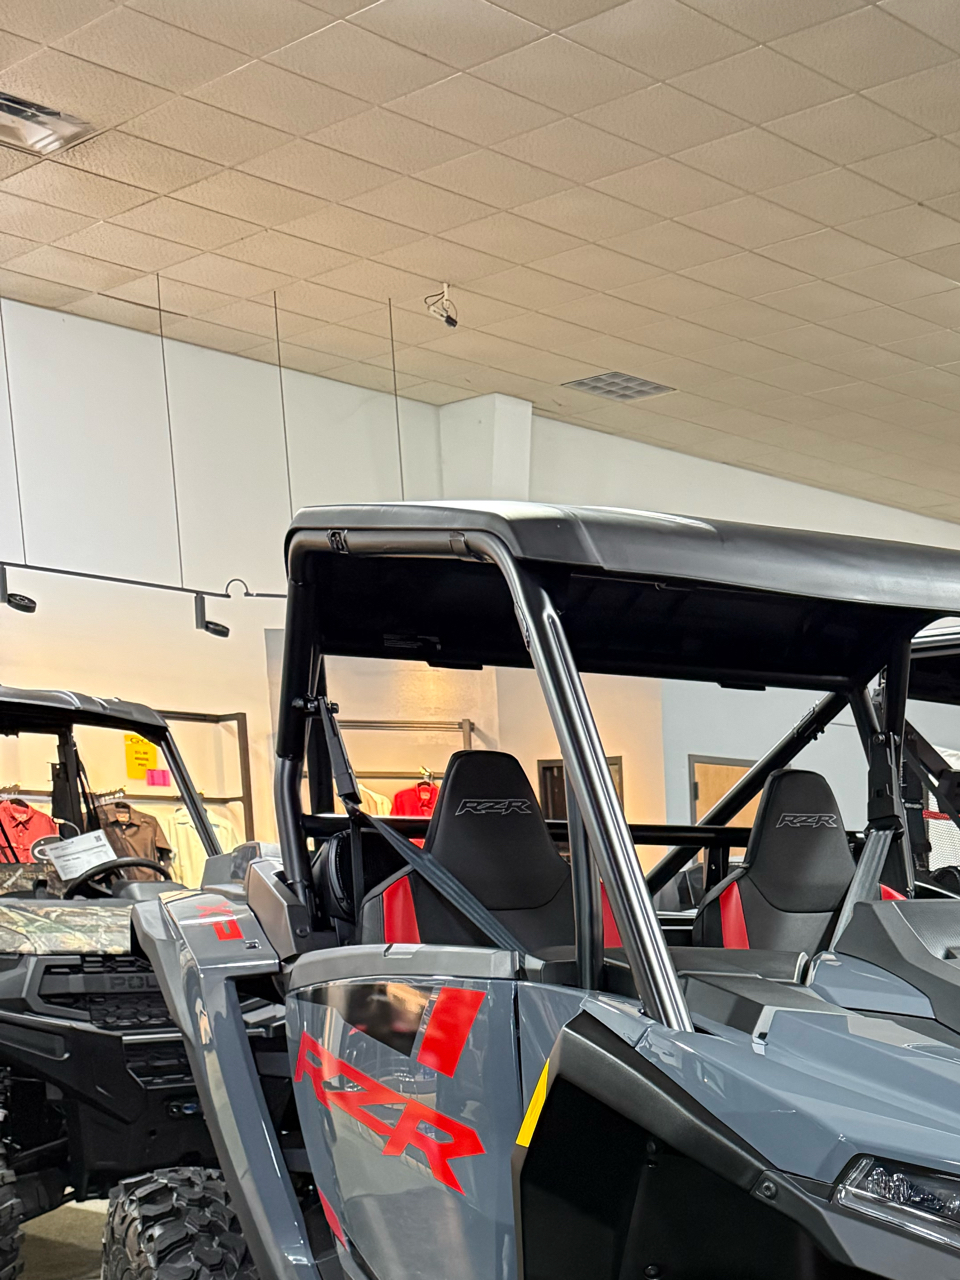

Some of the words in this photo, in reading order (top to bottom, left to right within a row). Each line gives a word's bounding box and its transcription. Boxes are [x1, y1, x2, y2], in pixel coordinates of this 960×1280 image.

[455, 799, 532, 816] RZR
[776, 813, 838, 828] RZR
[294, 1031, 486, 1197] RZR
